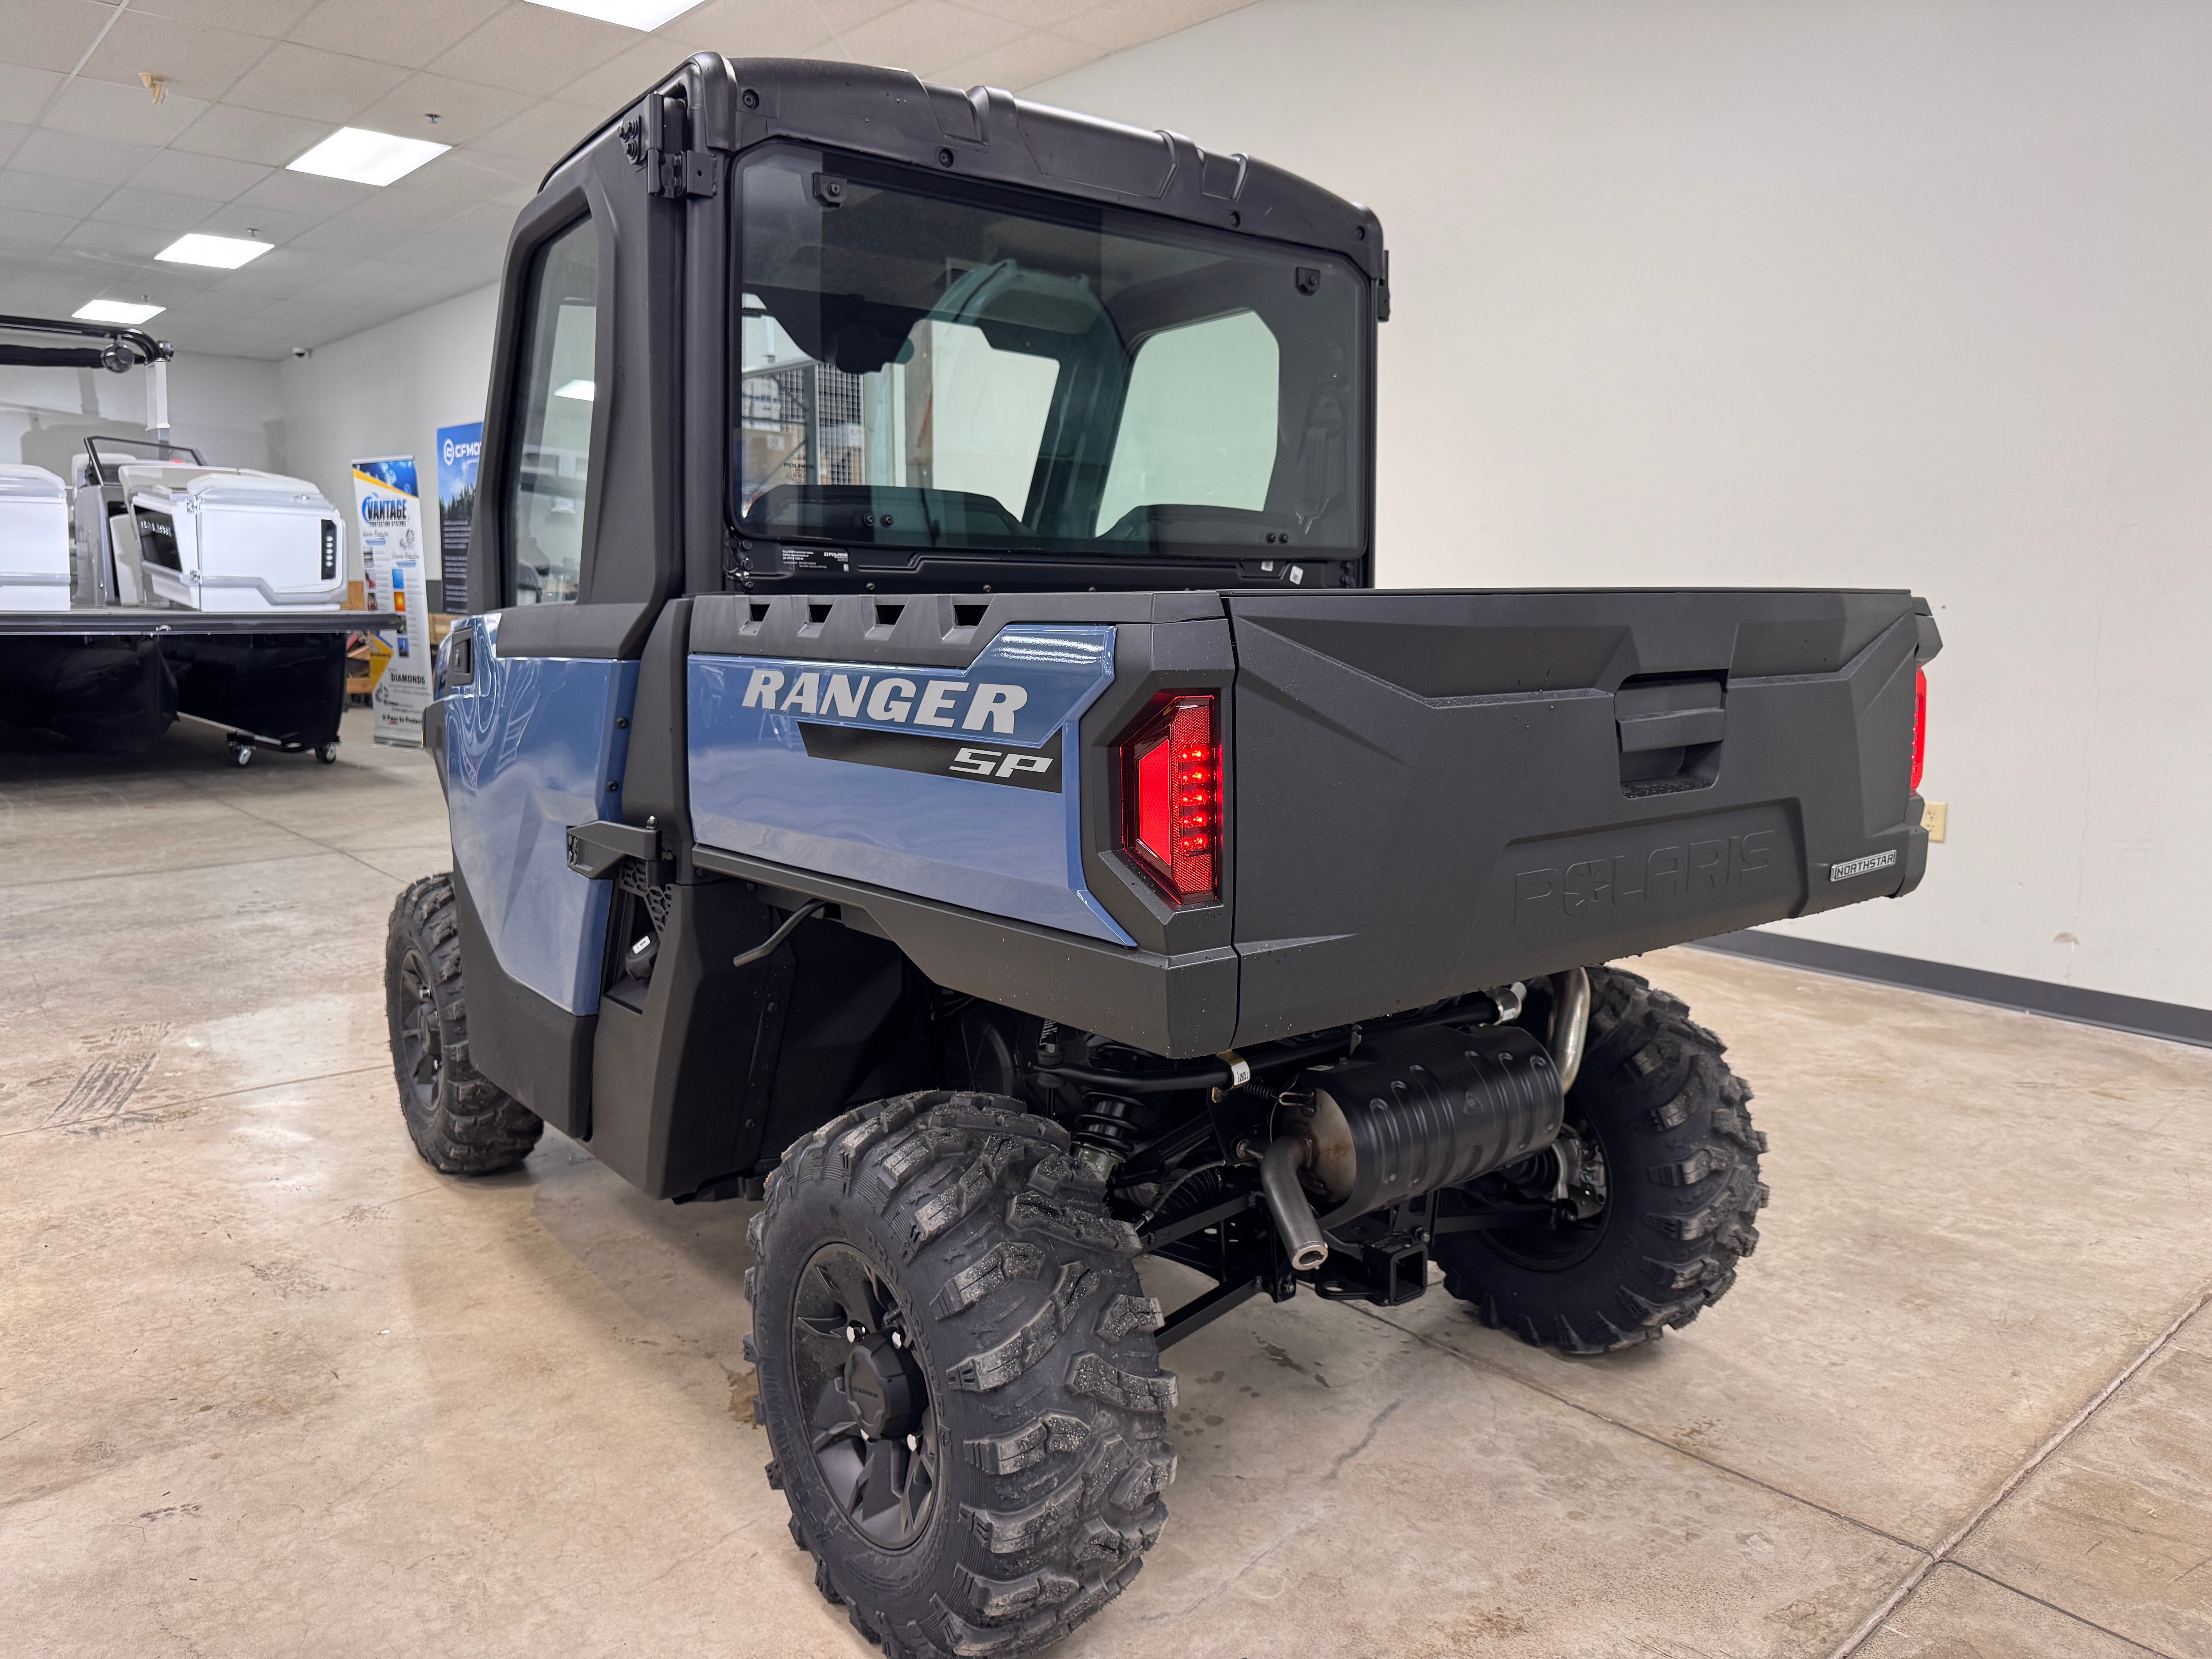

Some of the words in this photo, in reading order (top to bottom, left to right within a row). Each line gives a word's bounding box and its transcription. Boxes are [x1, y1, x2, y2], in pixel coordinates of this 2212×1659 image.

[367, 500, 407, 520] VANTAGE
[391, 673, 425, 685] DIAMONDS
[742, 669, 1028, 734] RANGER
[949, 747, 1053, 778] SP
[1513, 830, 1774, 928] POLARIS
[1837, 854, 1894, 878] NORTHSTAR
